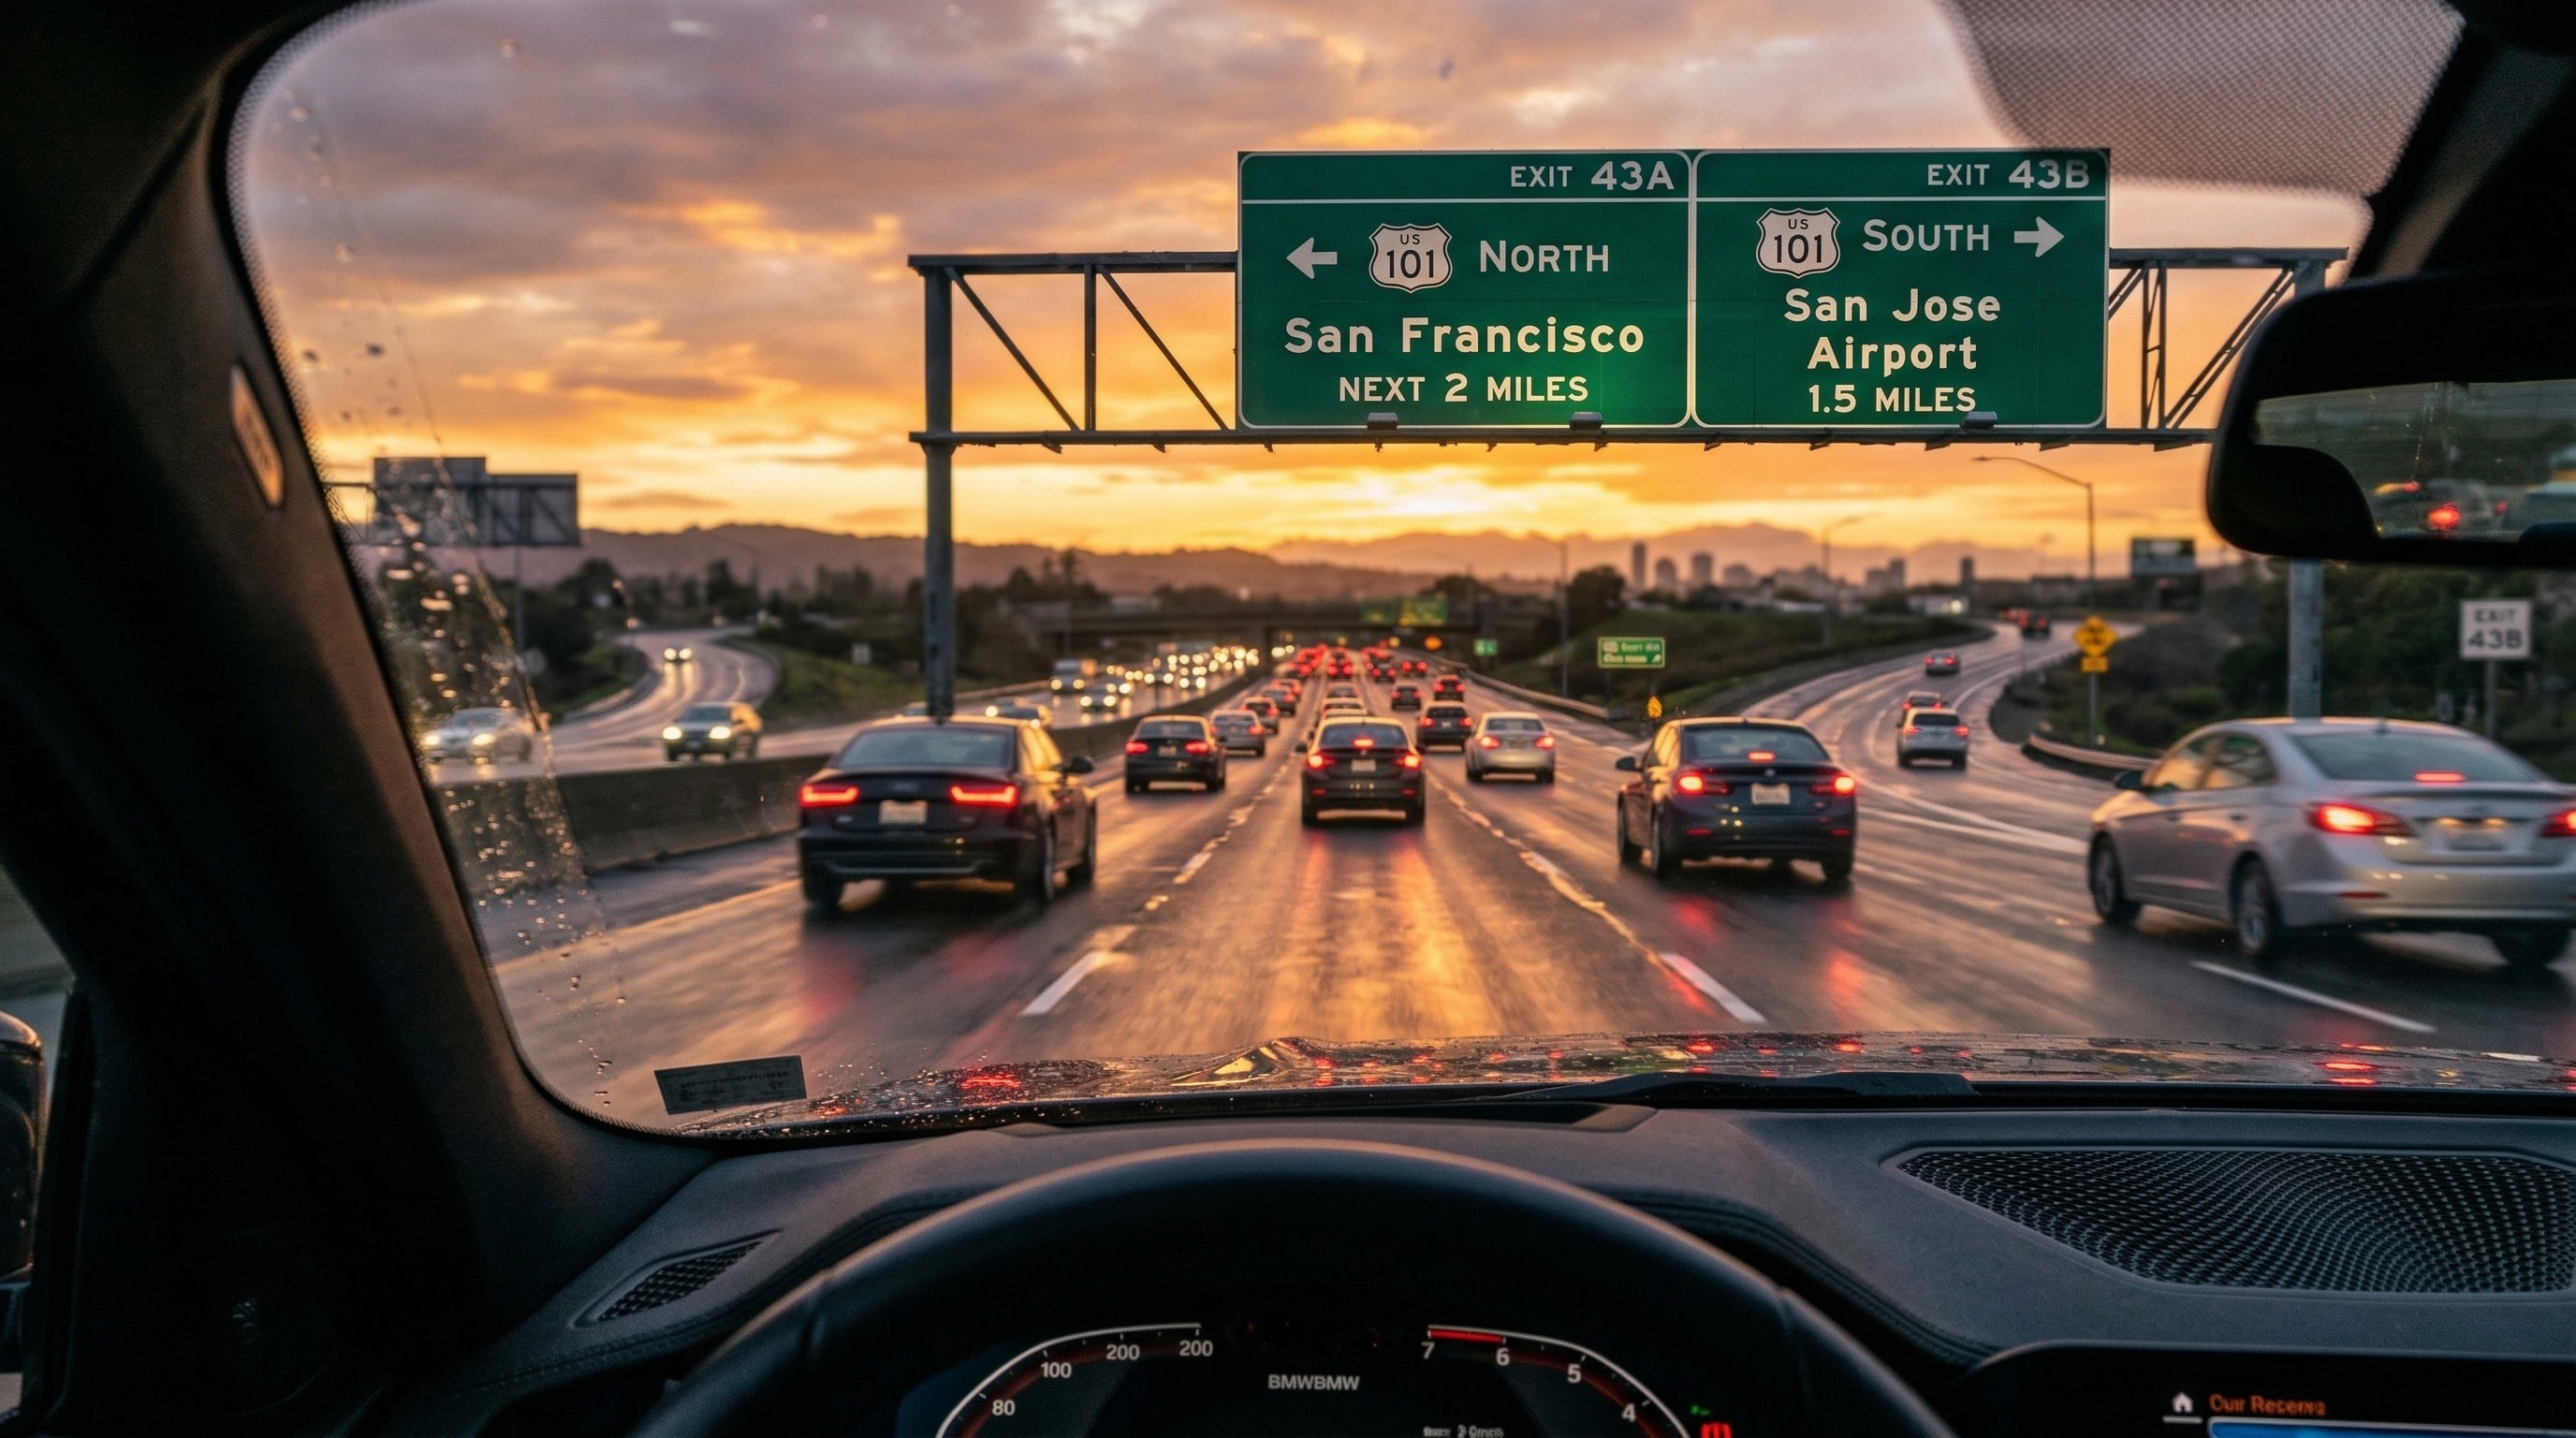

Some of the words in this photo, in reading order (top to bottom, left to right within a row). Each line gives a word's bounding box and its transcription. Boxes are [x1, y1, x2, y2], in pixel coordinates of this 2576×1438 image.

[1511, 166, 1573, 187] EXIT
[1591, 161, 1675, 190] 43A
[1927, 164, 1990, 186] EXIT
[2008, 159, 2090, 189] 43B
[1788, 218, 1808, 230] US
[1399, 233, 1420, 245] US
[1862, 219, 1990, 252] SOUTH
[1480, 240, 1609, 272] NORTH
[1774, 234, 1822, 264] 101
[1386, 250, 1435, 278] 101
[1783, 288, 1867, 322] San
[1892, 288, 2000, 323] Jose
[1284, 316, 1373, 354] San
[1402, 315, 1644, 354] Francisco
[1807, 336, 1978, 378] Airport
[1339, 376, 1426, 402] NEXT
[1444, 373, 1468, 403] 2
[1487, 376, 1588, 402] MILES
[1808, 384, 1856, 413] 1.5
[1875, 387, 1976, 413] MILES
[2468, 628, 2523, 650] 43B
[1106, 1344, 1140, 1360] 200
[1179, 1340, 1213, 1357] 200
[1422, 1342, 1435, 1358] 7
[1497, 1348, 1510, 1365] 6
[1041, 1362, 1072, 1378] 100
[1567, 1364, 1581, 1383] 5
[1268, 1374, 1360, 1390] BMWBMW
[991, 1400, 1015, 1416] 80
[1621, 1403, 1636, 1422] 4
